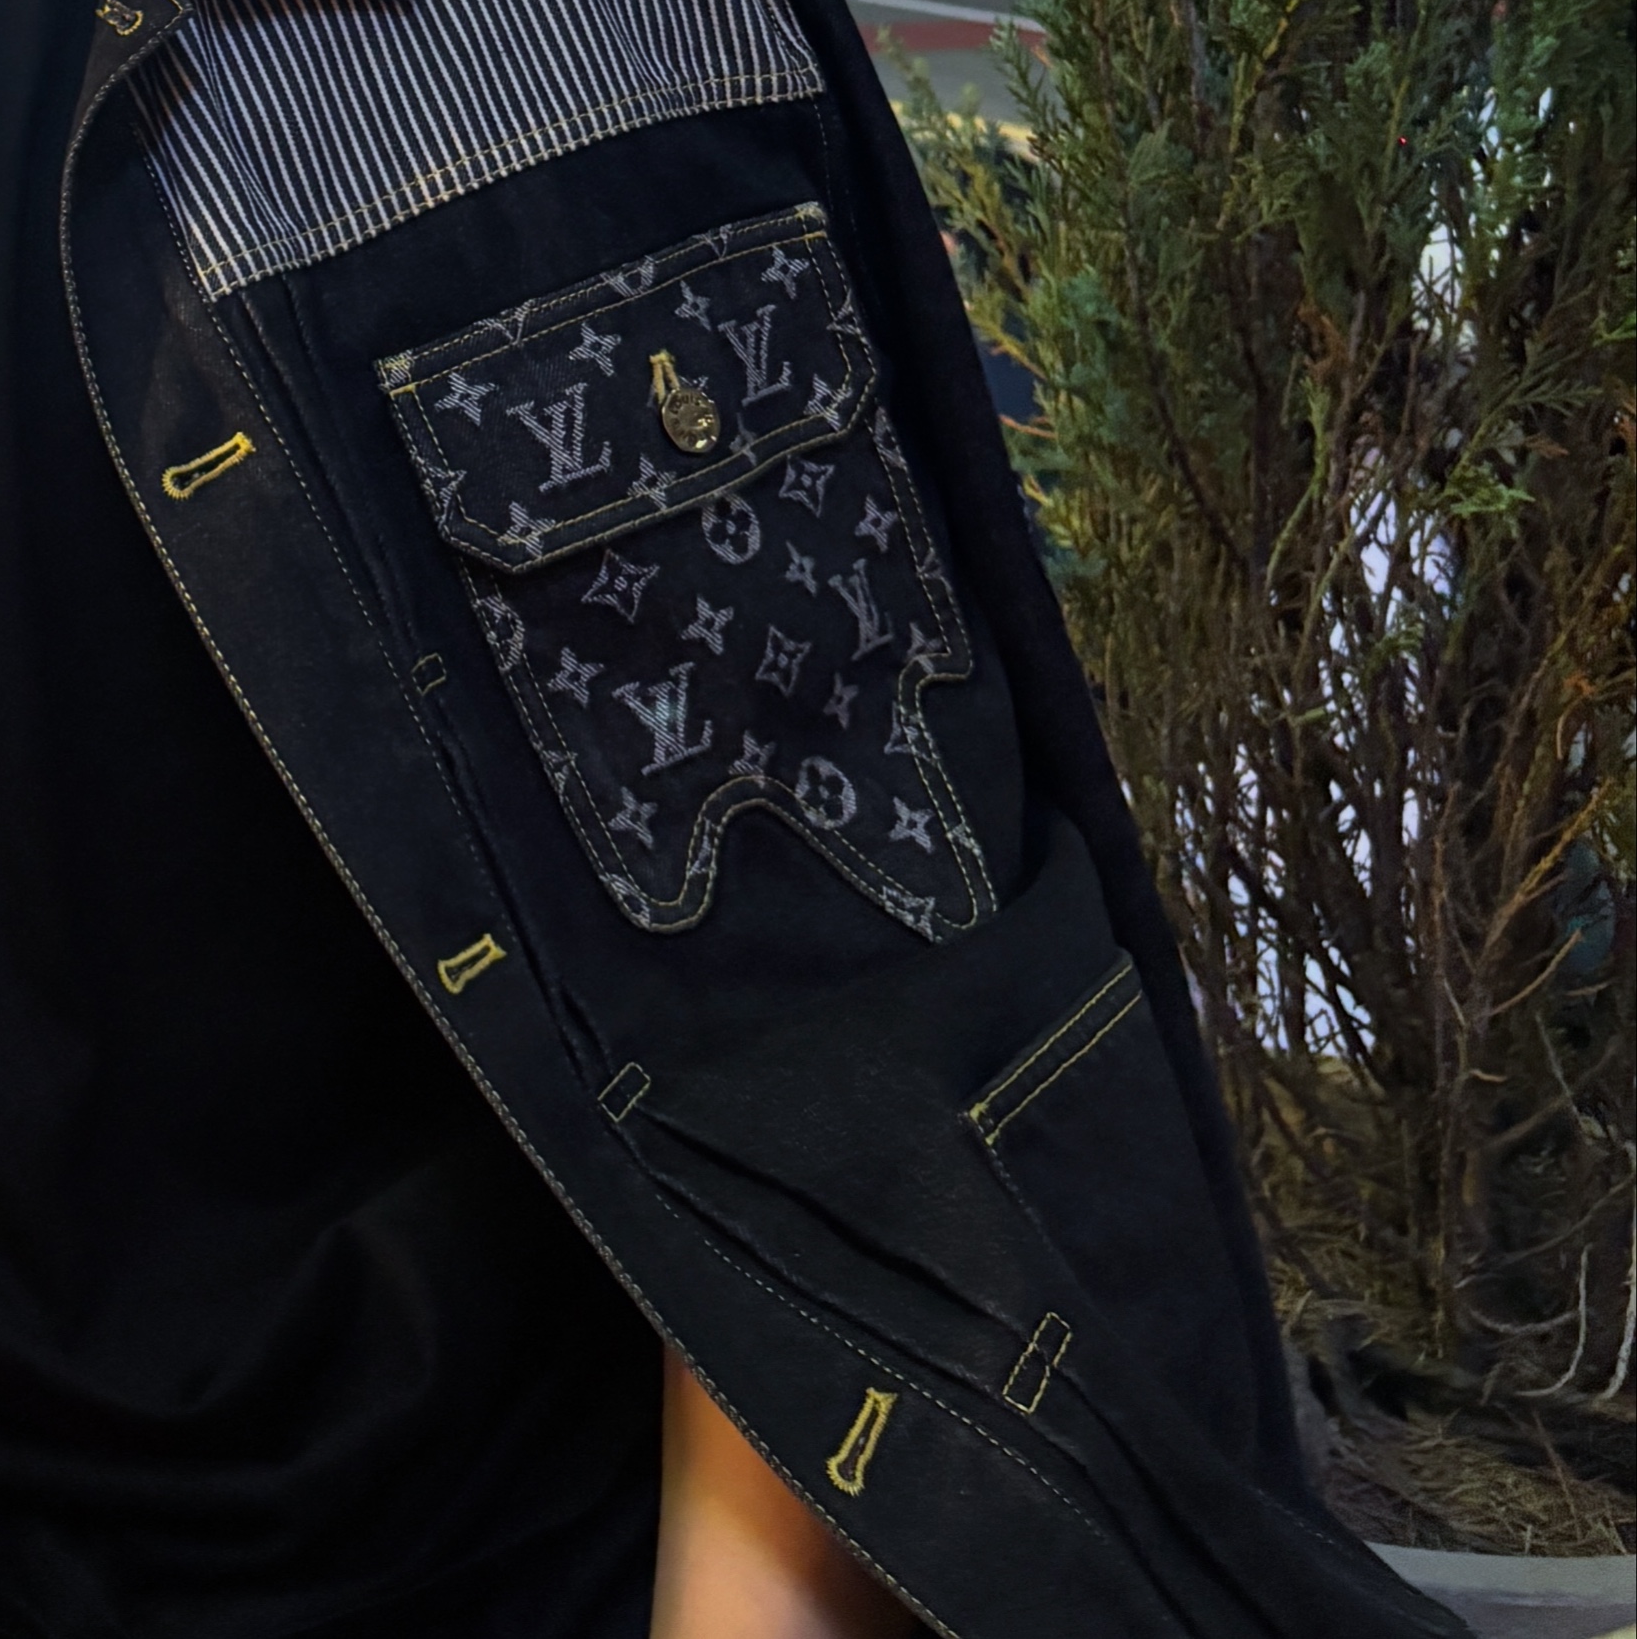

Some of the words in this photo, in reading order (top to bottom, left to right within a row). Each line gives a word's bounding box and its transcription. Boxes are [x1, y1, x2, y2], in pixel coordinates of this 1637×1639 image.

[717, 304, 793, 406] LV
[505, 382, 613, 493] LV
[828, 558, 893, 660] LV
[612, 662, 712, 775] LV
